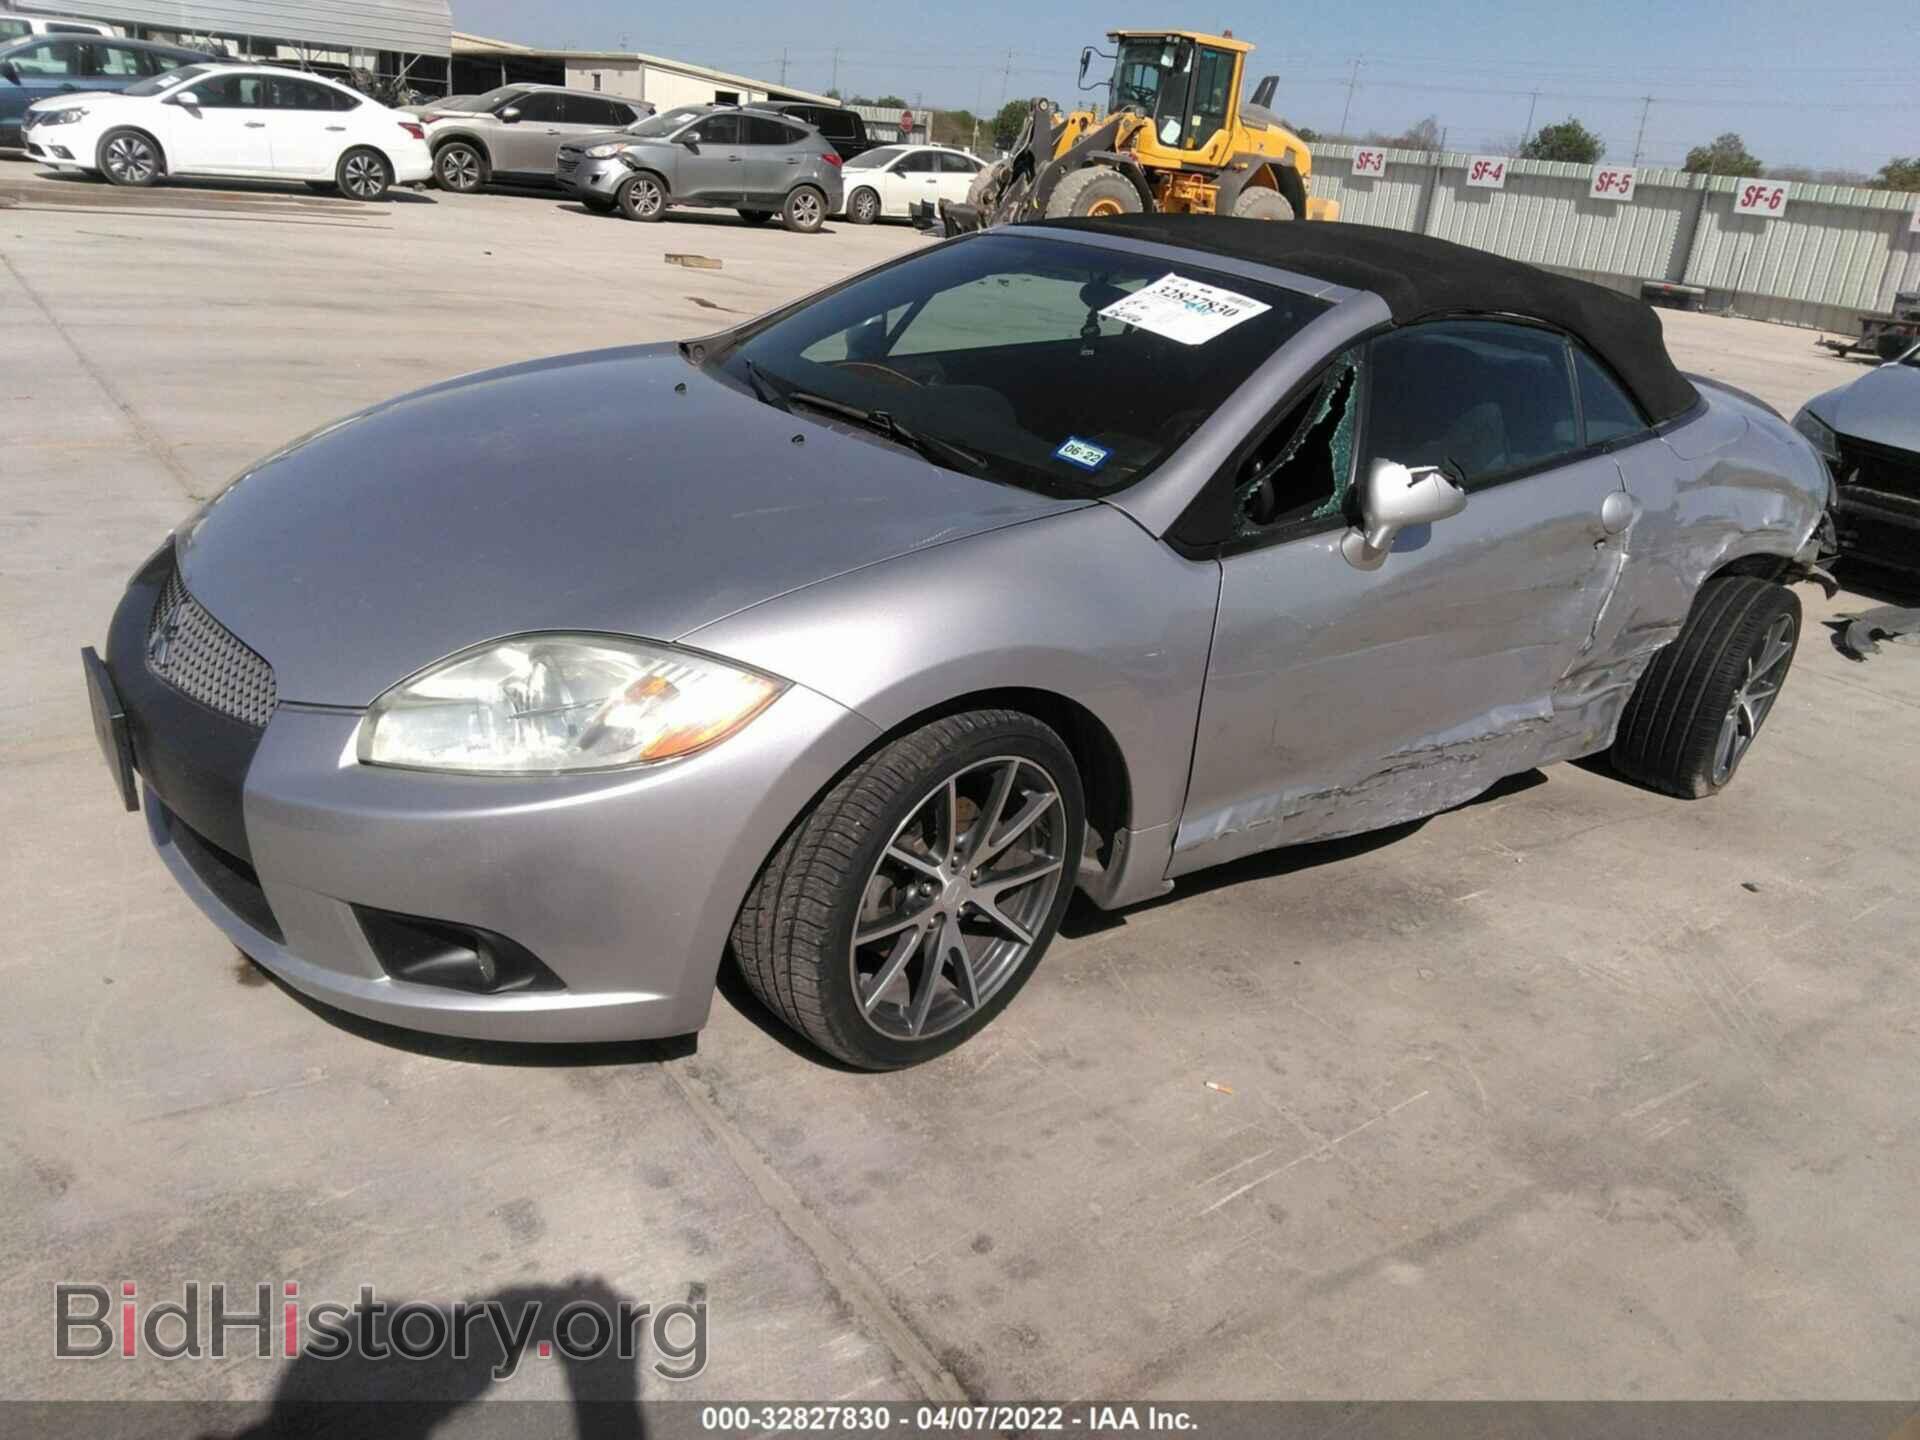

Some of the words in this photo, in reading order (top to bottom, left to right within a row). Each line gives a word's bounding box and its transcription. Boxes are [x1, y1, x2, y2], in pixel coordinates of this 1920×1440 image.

[1356, 152, 1384, 171] SF-3
[1472, 161, 1504, 181] SF-4
[1595, 171, 1632, 193] SF-5
[1741, 184, 1784, 210] SF-6
[1160, 286, 1240, 317] 32827830
